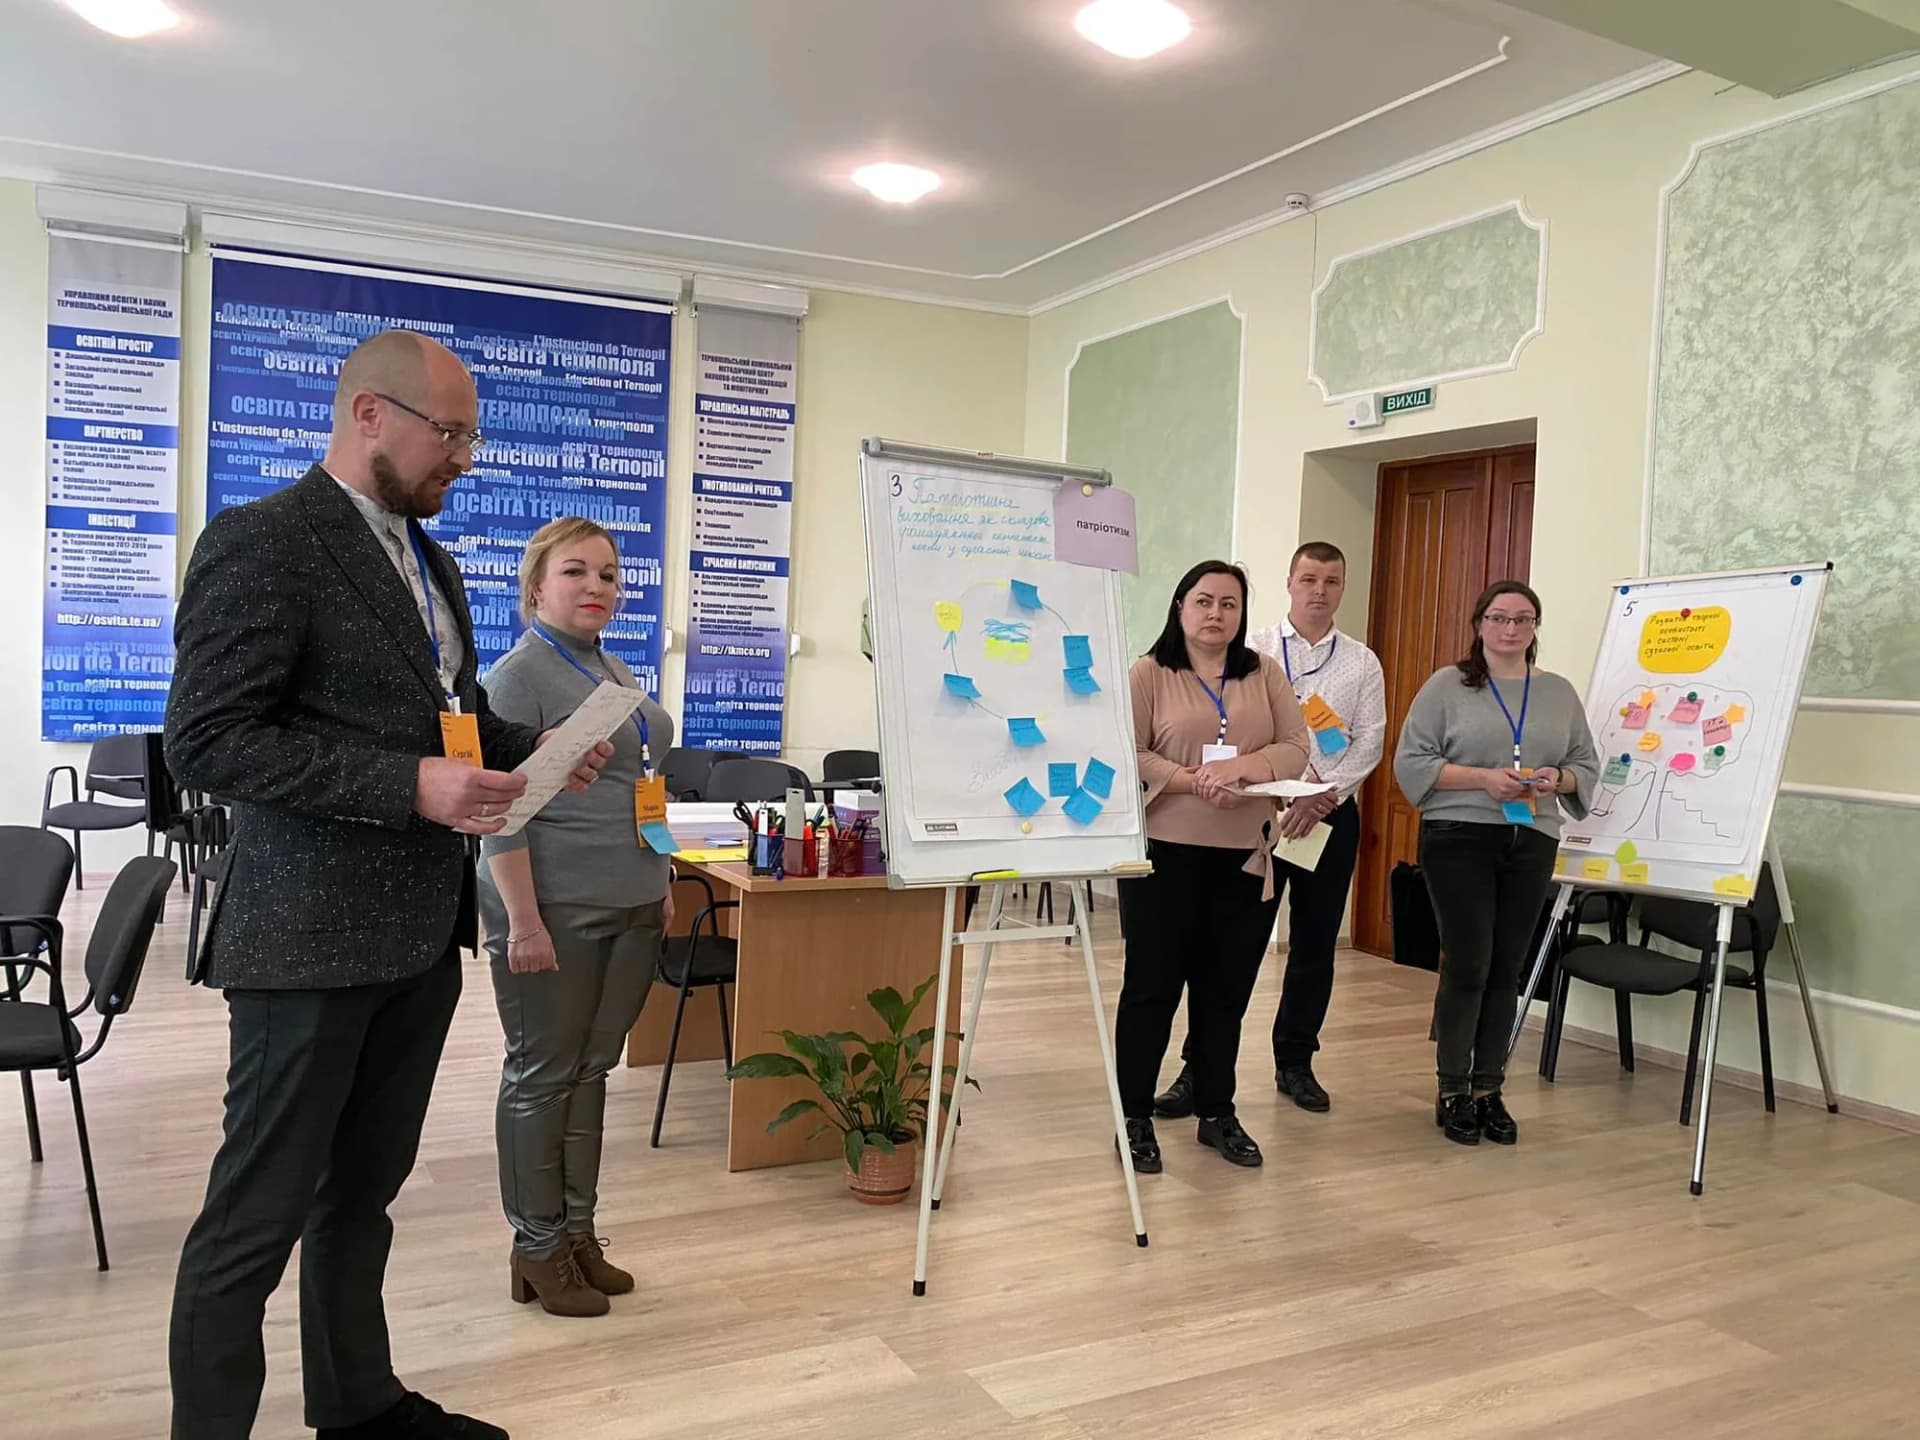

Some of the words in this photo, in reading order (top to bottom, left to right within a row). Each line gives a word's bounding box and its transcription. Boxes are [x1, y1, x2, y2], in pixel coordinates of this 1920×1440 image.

[64, 290, 110, 302] УПРАВЛІННЯ
[111, 295, 138, 305] ОСВІТИ
[143, 298, 167, 308] НАУКИ
[57, 299, 120, 313] ТЕРНОПІЛЬСЬКОЇ
[121, 306, 152, 317] МІСЬКОЇ
[153, 310, 173, 319] РАДИ
[76, 334, 116, 350] ОСВІТНІЙ
[117, 338, 154, 353] ПРОСТІР
[605, 343, 618, 355] de
[620, 344, 666, 361] Ternopil
[231, 395, 297, 419] ОСВІТА
[1387, 390, 1427, 410] ВИХІД
[700, 399, 749, 416] УПРАВЛІНСЬКА
[749, 404, 790, 420] МАГІСТРАЛЬ
[83, 424, 144, 442] ПАРТНЕРСТВО
[212, 420, 280, 438] L'instruction
[281, 426, 296, 438] de
[701, 479, 753, 495] УМОТИВОВАНИЙ
[754, 483, 783, 497] УЧИТЕЛЬ
[890, 474, 903, 498] 3
[452, 491, 526, 518] ОСВІТА
[530, 498, 642, 526] ТЕРНОПОЛЯ
[87, 513, 137, 529] ІНВЕСТИЦІЇ
[1076, 518, 1131, 538] патріотизм
[702, 556, 737, 571] СУЧАСНИЙ
[1622, 600, 1639, 617] 5
[57, 612, 162, 628] http://osvita.te.ua/
[701, 644, 770, 659] http://tkmco.org
